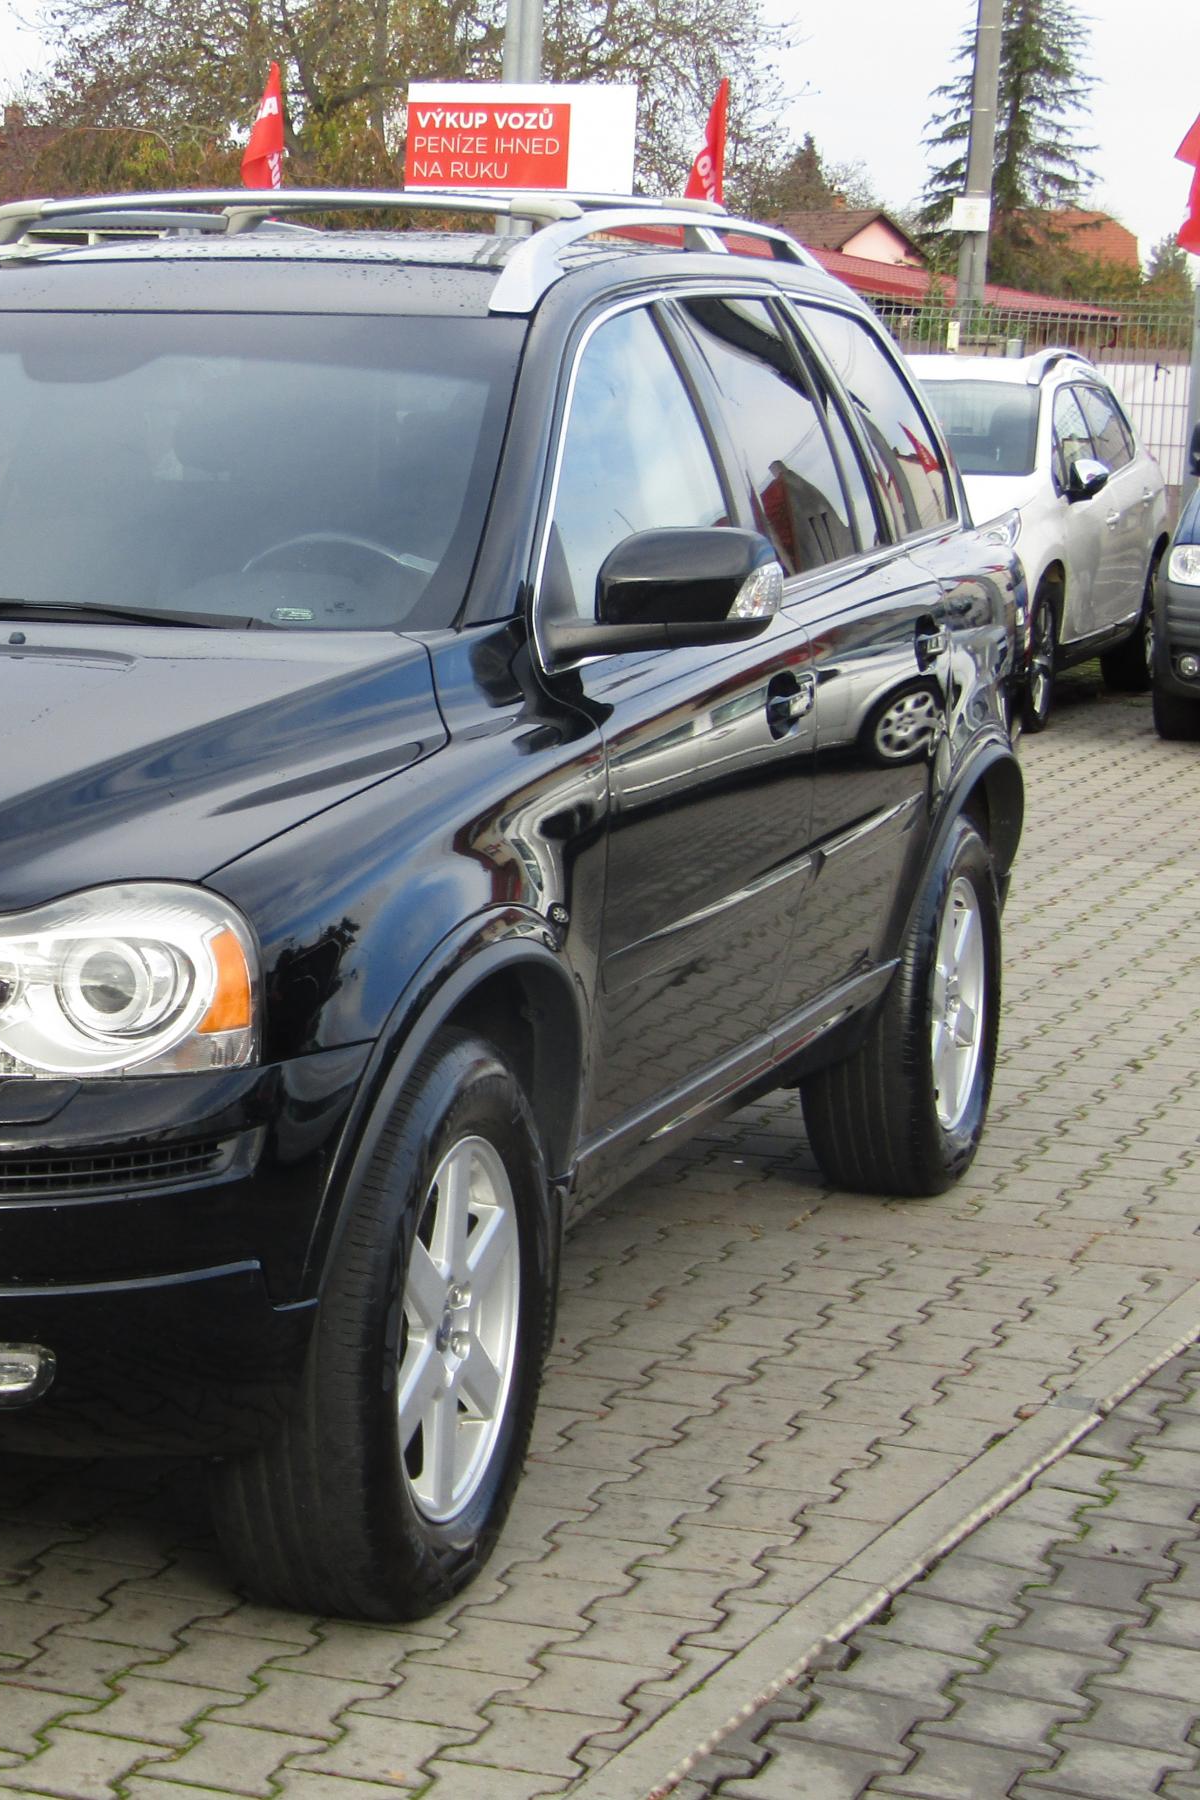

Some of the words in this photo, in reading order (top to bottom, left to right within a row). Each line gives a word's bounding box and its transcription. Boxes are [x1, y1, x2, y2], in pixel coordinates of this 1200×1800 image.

[416, 108, 488, 129] VÝKUP
[493, 108, 554, 130] VOZŮ
[414, 133, 488, 154] PENÍZE
[495, 137, 560, 155] IHNED
[413, 161, 443, 178] NA
[450, 161, 508, 179] RUKU
